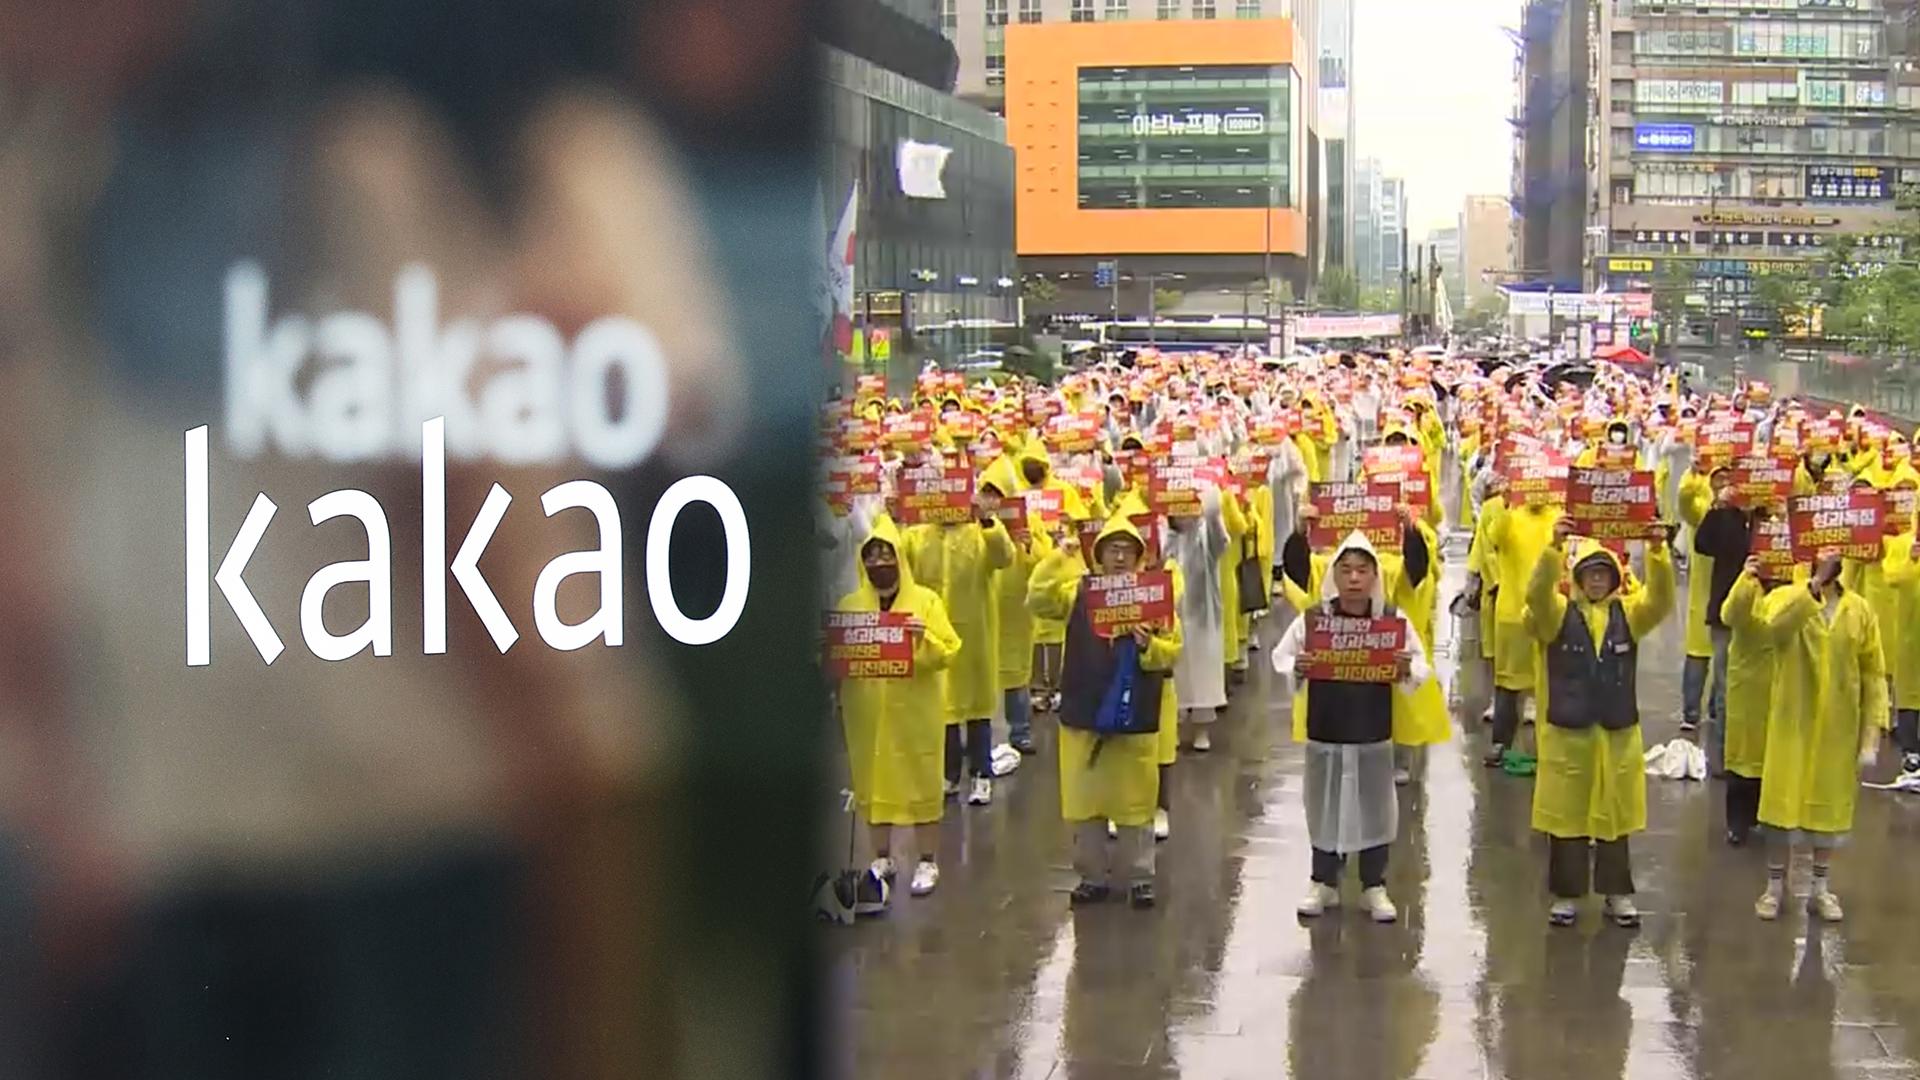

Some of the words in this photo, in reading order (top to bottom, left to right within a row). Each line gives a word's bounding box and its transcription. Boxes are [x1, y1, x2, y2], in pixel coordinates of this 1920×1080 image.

[1132, 113, 1222, 136] 아브뉴프랑
[222, 257, 669, 470] kakao
[1333, 496, 1392, 513] 성과독점
[1811, 508, 1875, 528] 성과독점
[184, 415, 752, 667] kakao
[1105, 584, 1164, 607] 성과독점
[844, 626, 904, 644] 성과독점
[1331, 631, 1397, 650] 성과독점
